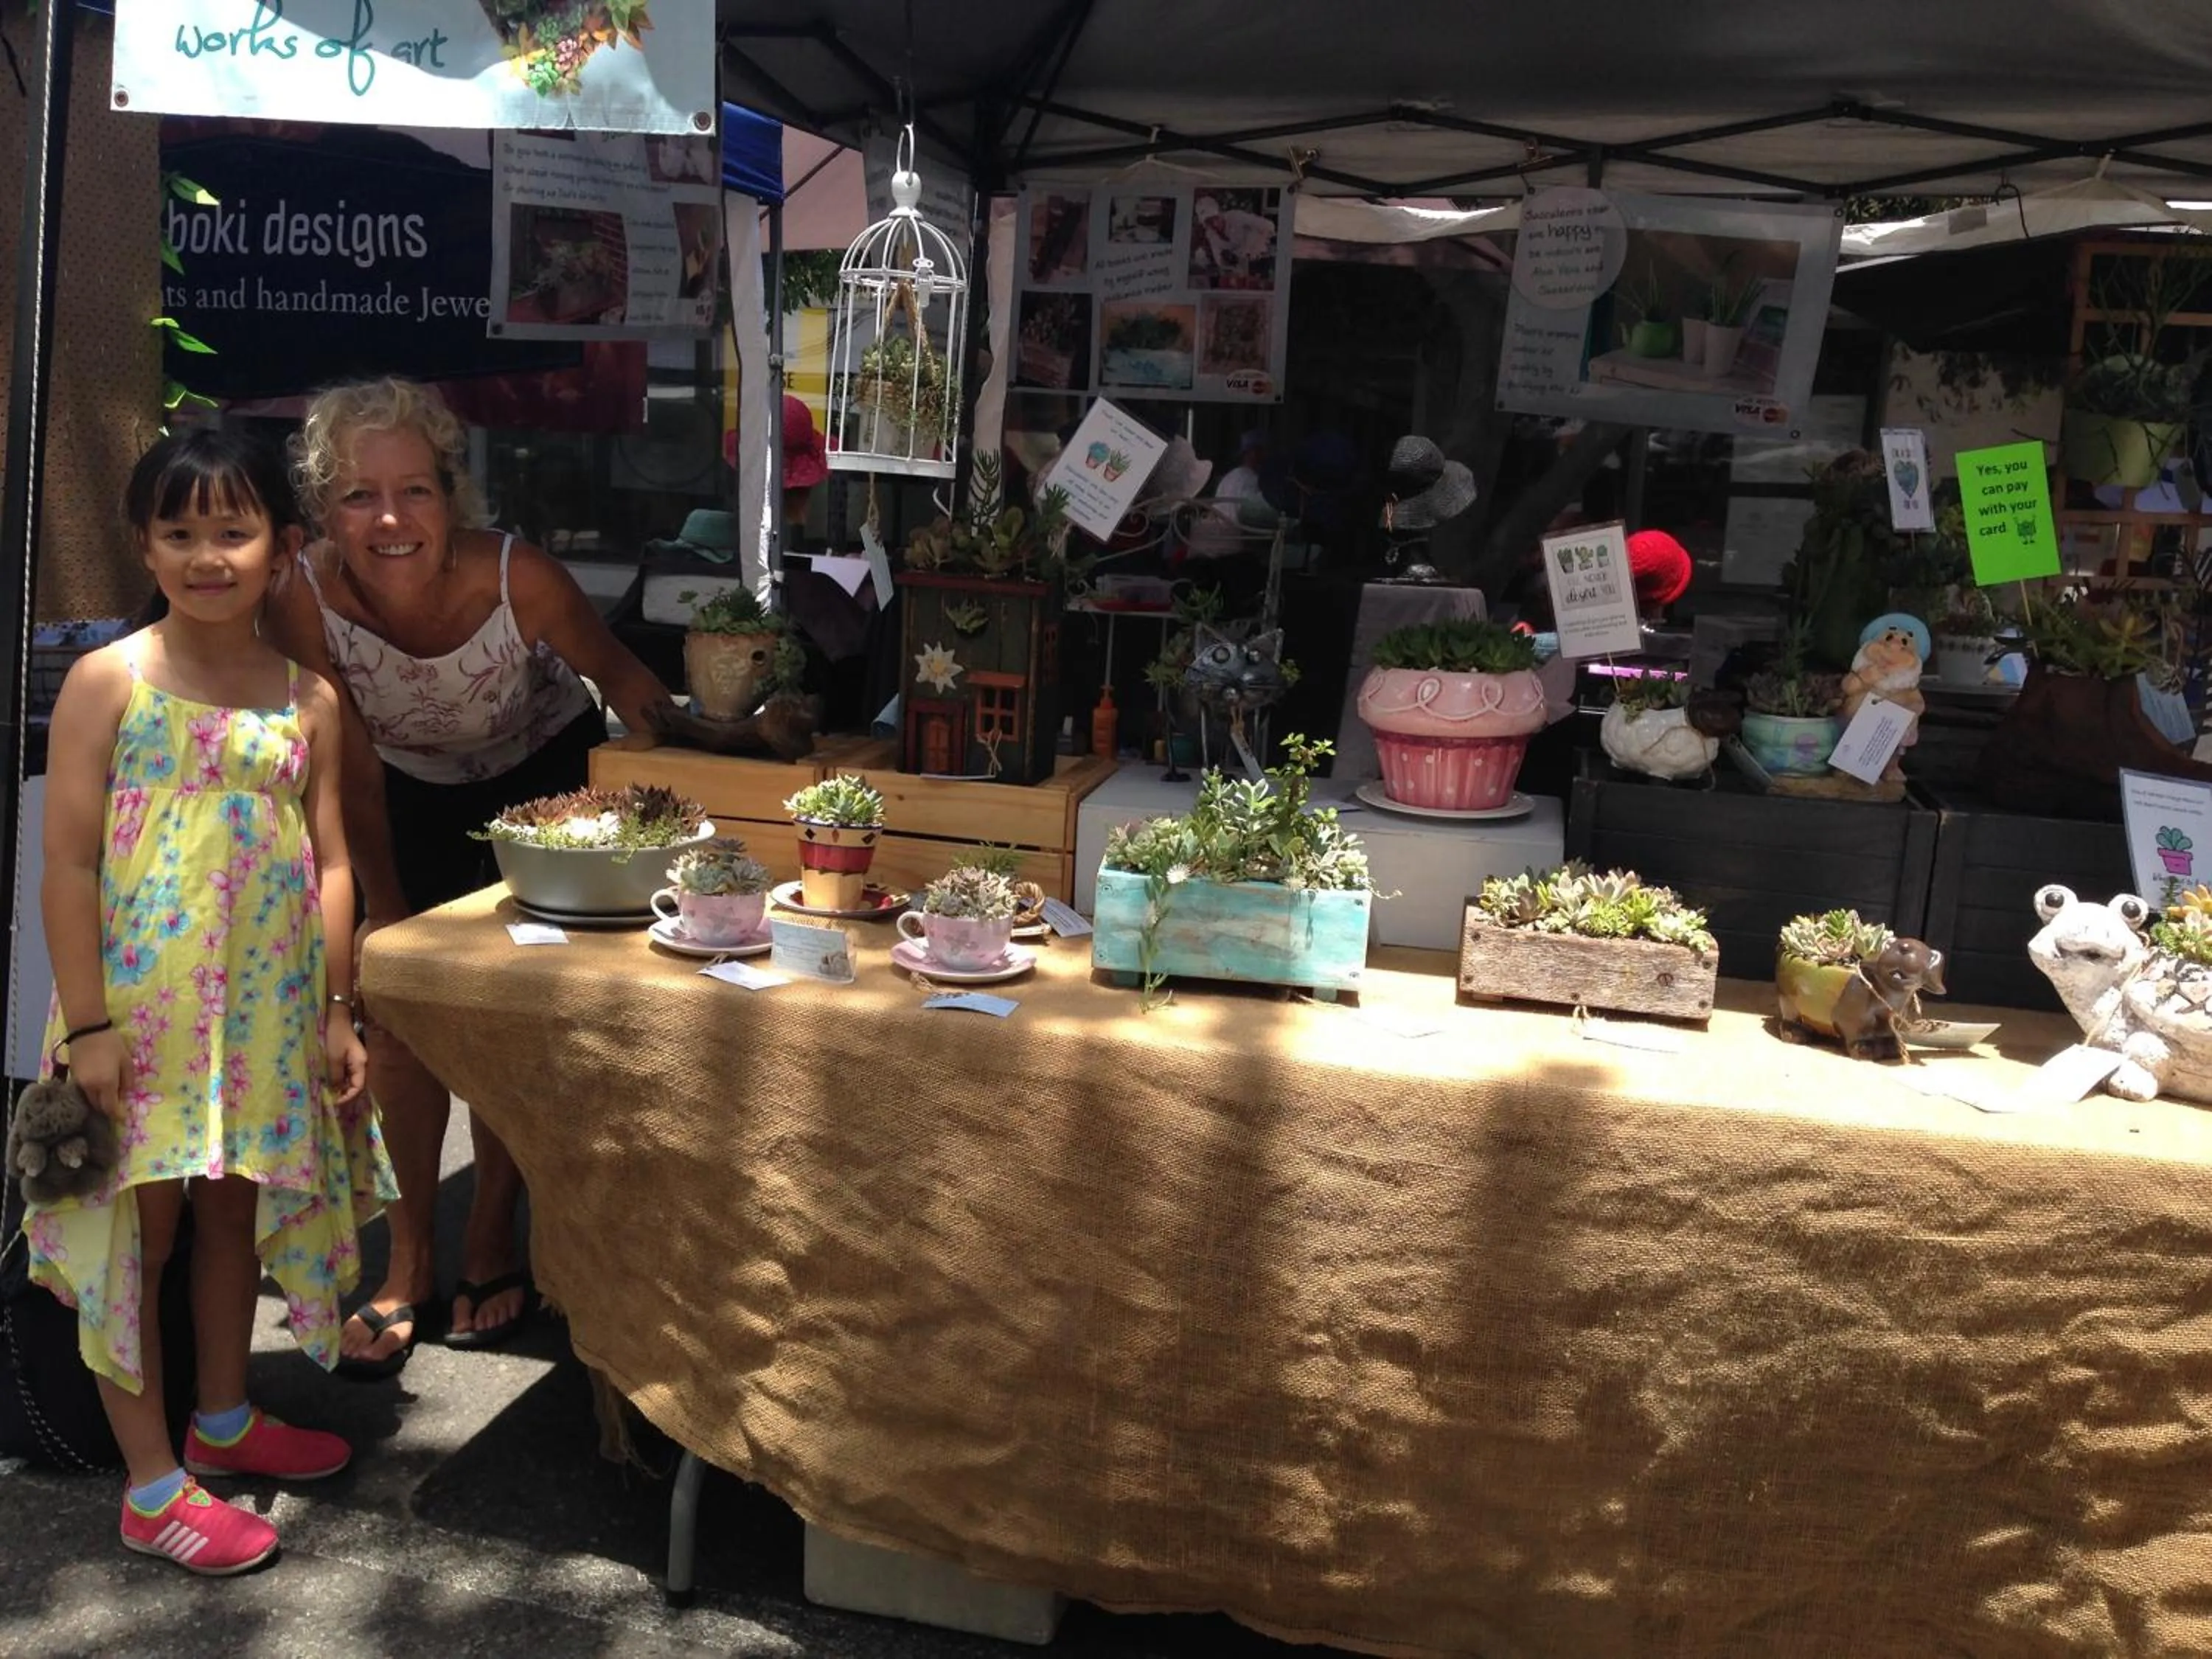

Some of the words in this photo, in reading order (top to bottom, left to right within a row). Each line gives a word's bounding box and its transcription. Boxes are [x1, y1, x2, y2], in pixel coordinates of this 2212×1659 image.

[175, 0, 298, 59] works
[315, 0, 375, 96] of
[391, 28, 448, 68] art
[168, 198, 251, 256] boki
[263, 198, 428, 268] designs
[1548, 223, 1592, 242] happy
[196, 277, 246, 310] and
[257, 275, 410, 316] handmade
[417, 287, 492, 322] Jewe
[1226, 378, 1249, 389] VISA
[1735, 403, 1761, 415] VISA
[1975, 465, 2002, 476] Yes,
[2005, 461, 2028, 474] you
[1982, 484, 2003, 495] can
[2006, 481, 2028, 495] pay
[1978, 502, 2006, 516] with
[2009, 499, 2037, 514] your
[1980, 521, 2006, 535] card
